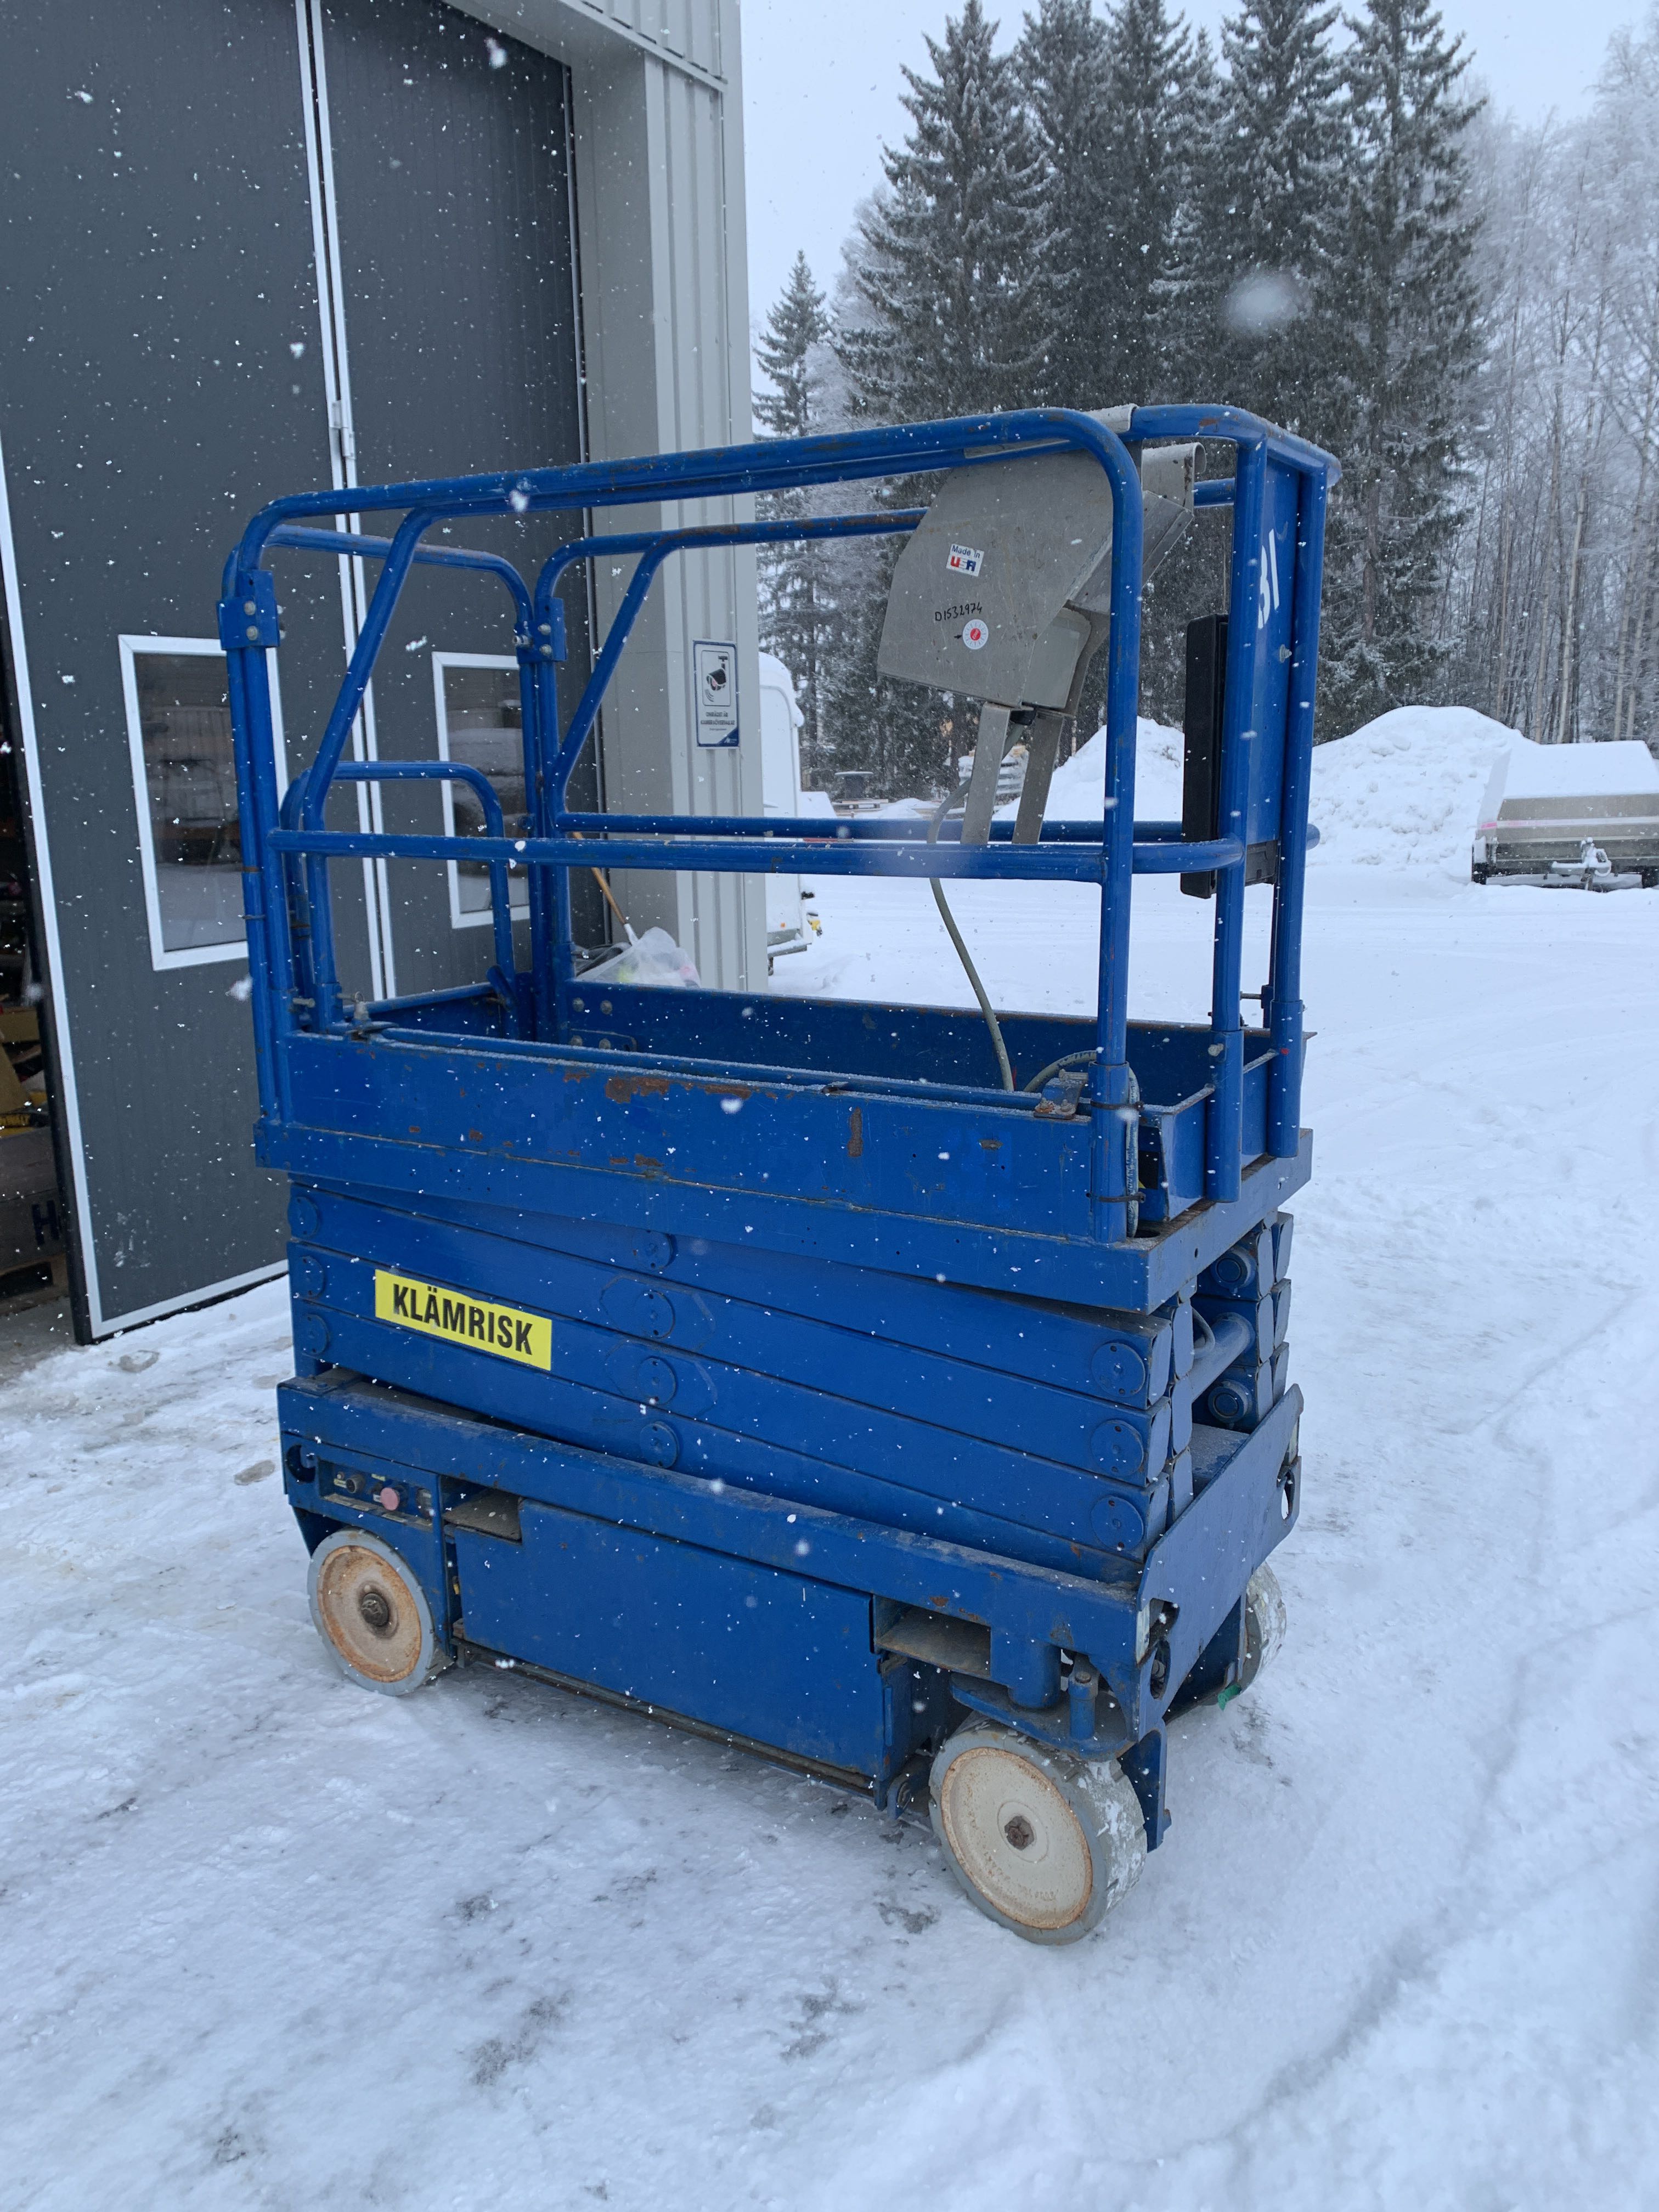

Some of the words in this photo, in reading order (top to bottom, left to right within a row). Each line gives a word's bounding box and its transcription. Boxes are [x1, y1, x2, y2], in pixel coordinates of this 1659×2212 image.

[952, 545, 971, 556] Made
[974, 550, 980, 558] in
[950, 556, 977, 572] USA
[393, 1283, 533, 1355] KLÄMRISK
